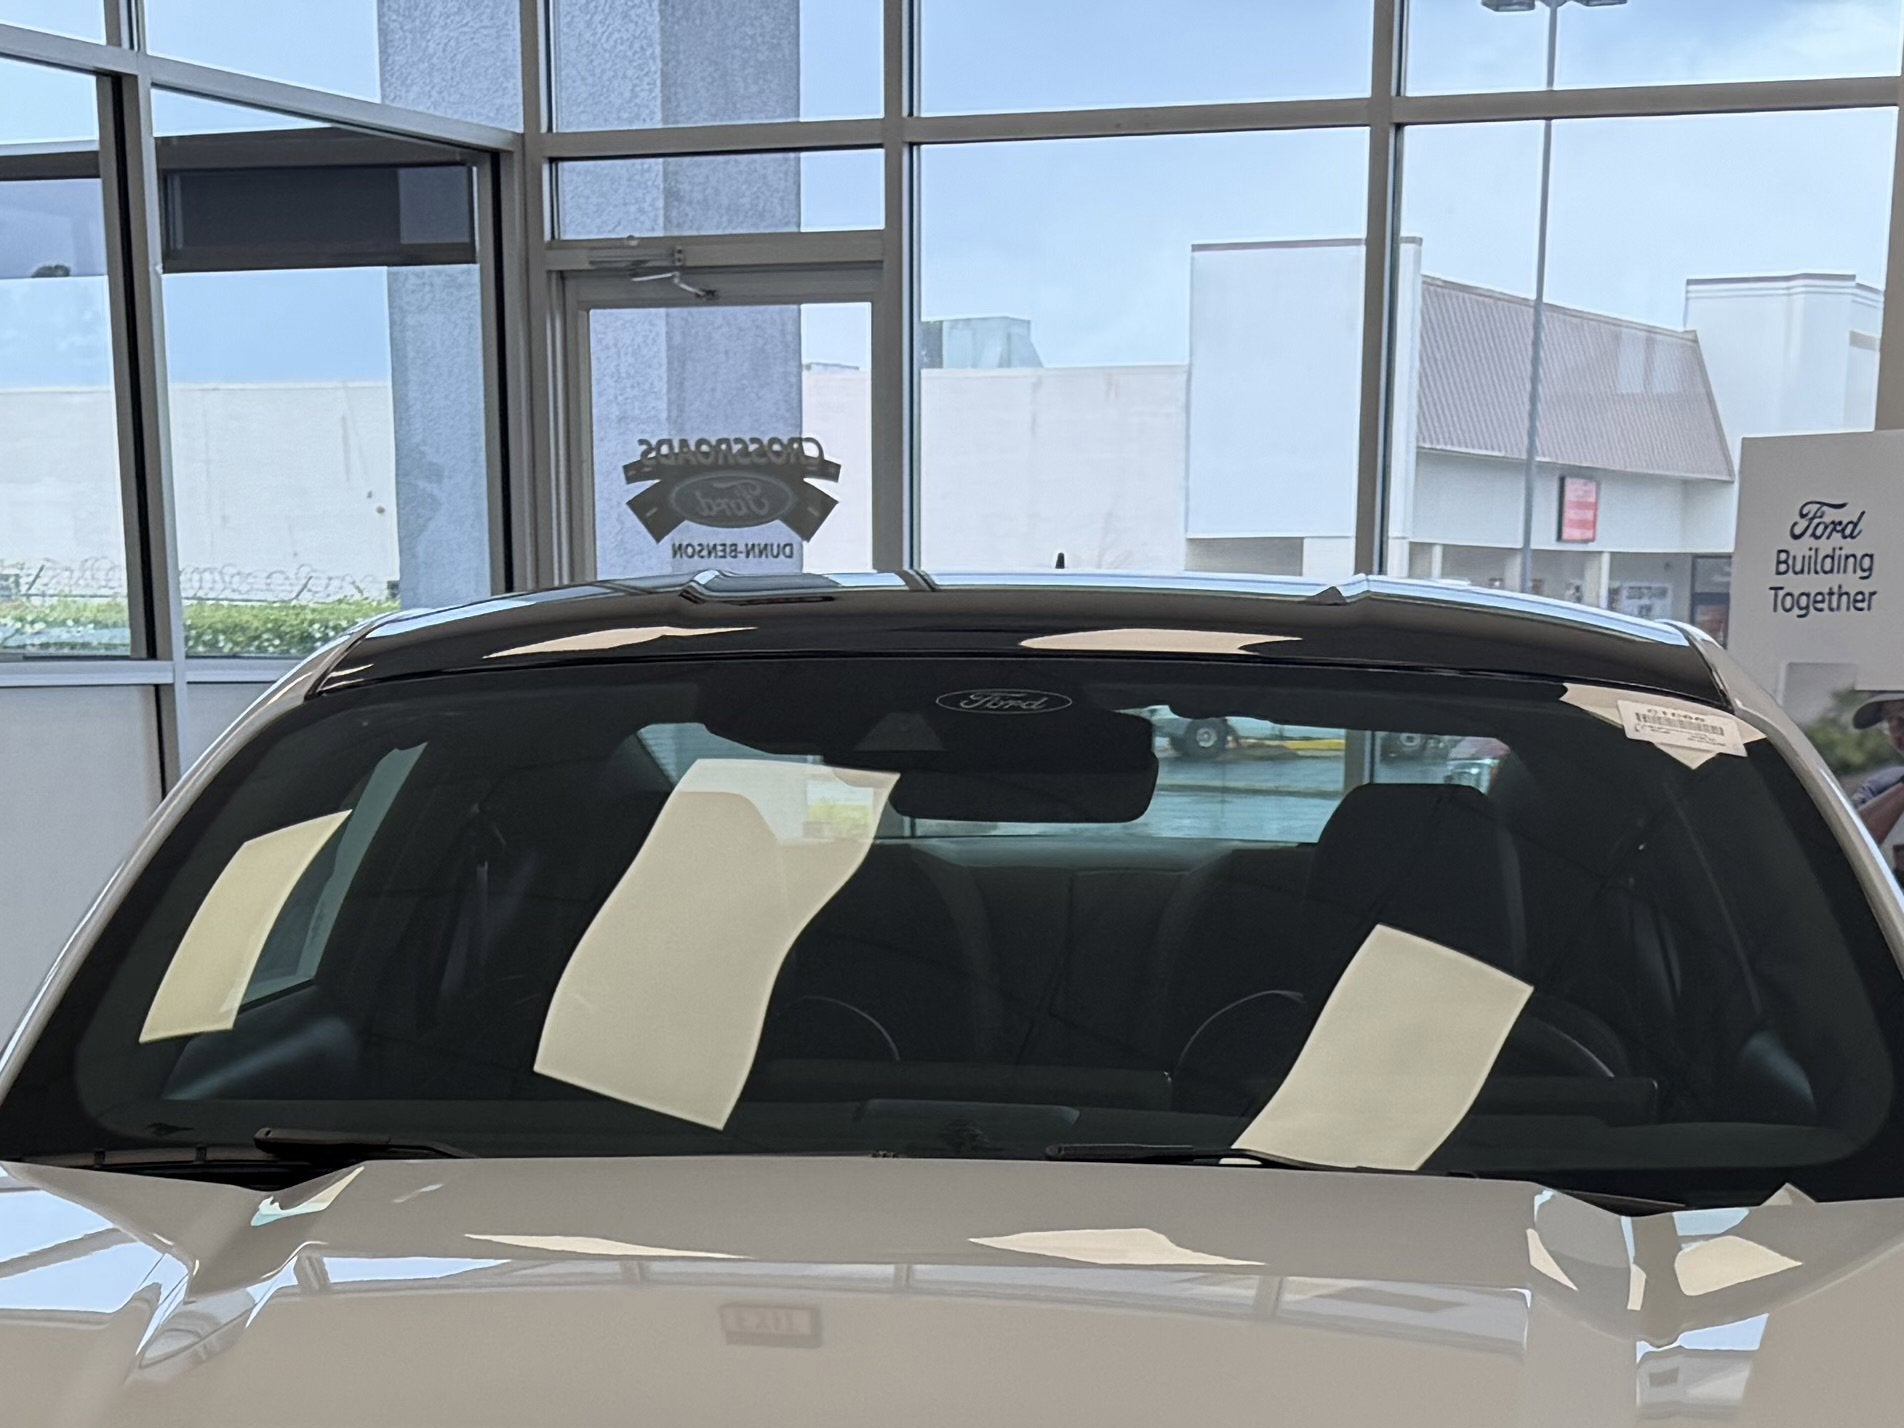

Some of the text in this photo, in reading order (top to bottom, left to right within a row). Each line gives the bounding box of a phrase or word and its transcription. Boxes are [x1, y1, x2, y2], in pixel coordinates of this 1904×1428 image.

[1789, 500, 1866, 541] Ford
[1774, 547, 1875, 580] Building
[1768, 584, 1878, 618] Together
[959, 691, 1049, 709] Ford
